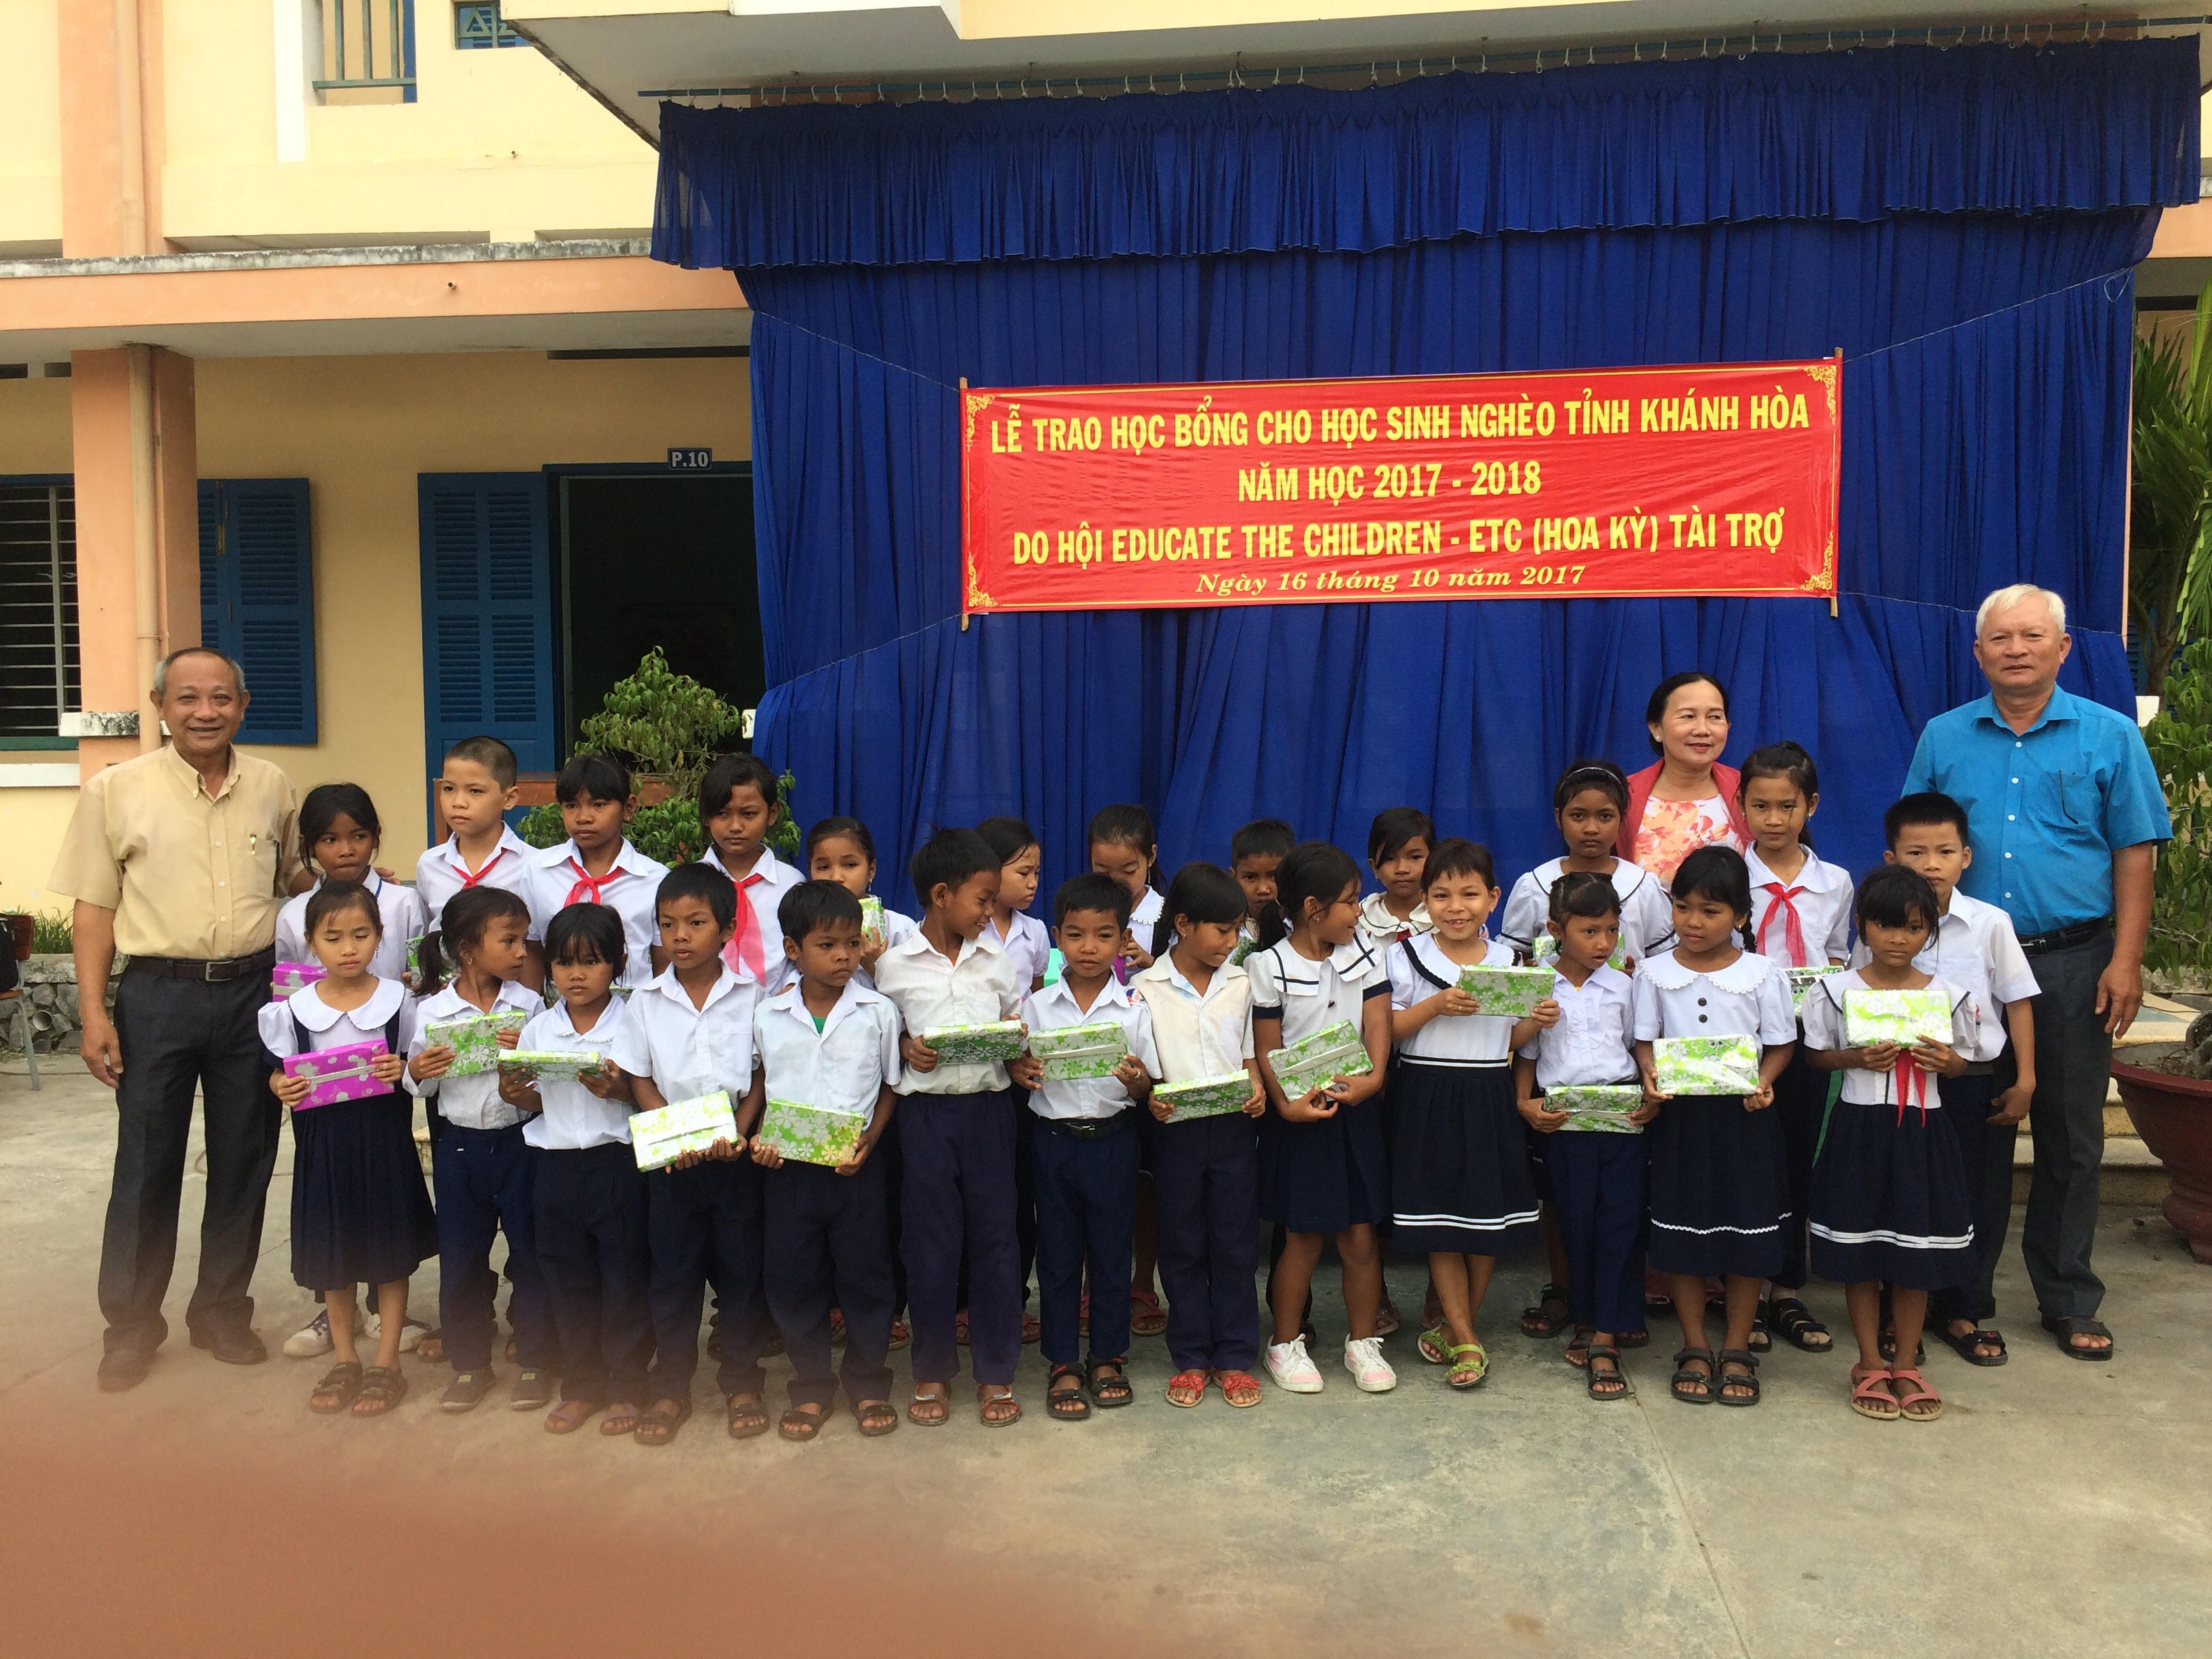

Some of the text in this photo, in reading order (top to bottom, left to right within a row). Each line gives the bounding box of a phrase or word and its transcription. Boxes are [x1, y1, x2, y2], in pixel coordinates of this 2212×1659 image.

[991, 385, 1809, 455] LỄ TRAO HỌC BỔNG CHO HỌC SINH NGHÈO TỈNH KHÁNH HÒA
[672, 451, 708, 467] P.10
[1238, 460, 1542, 506] NĂM HỌC 2017 - 2018
[1014, 504, 1785, 570] DO HỘI EDUCATE THE CHILDREN - ETC (HOA KỲ) TÀI TRỢ
[1195, 565, 1586, 597] Ngày 16 tháng 10 năm 2017
